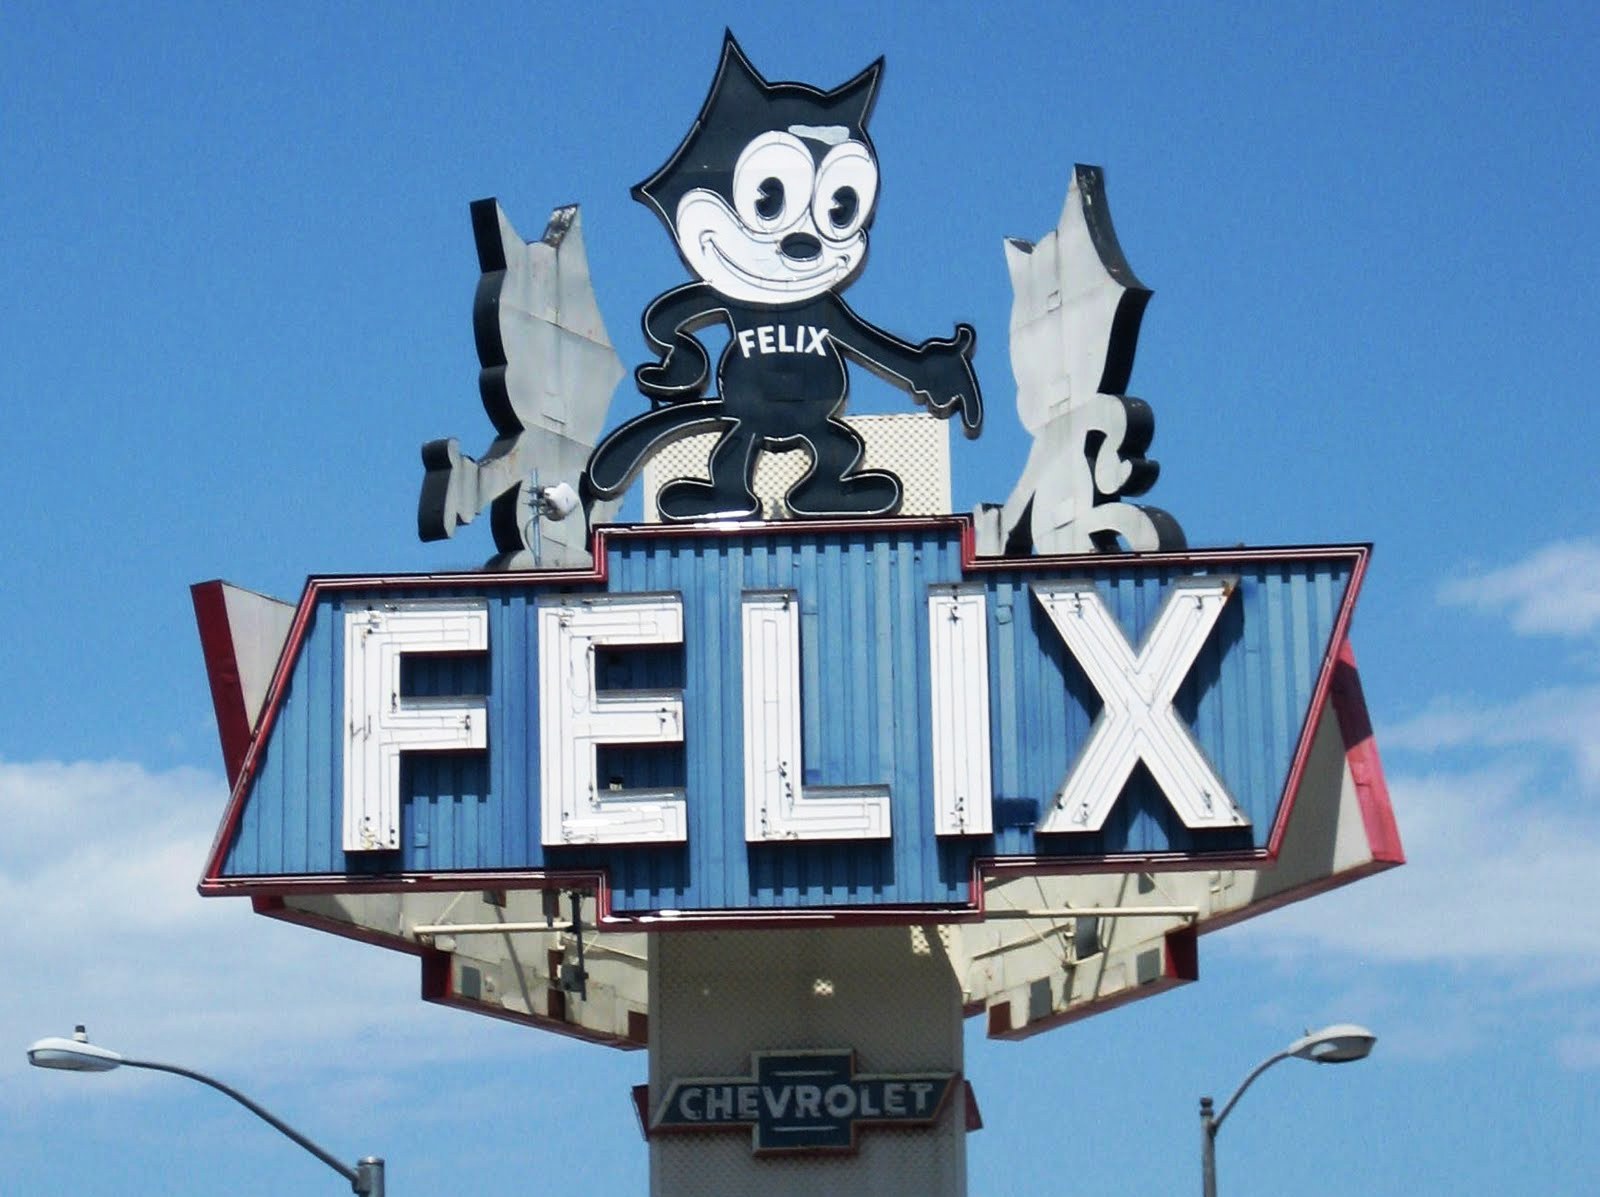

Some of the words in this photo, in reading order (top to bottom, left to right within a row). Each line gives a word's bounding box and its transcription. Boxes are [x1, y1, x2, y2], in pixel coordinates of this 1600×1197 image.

[738, 325, 829, 358] FELIX
[342, 579, 1251, 852] FELIX
[679, 1083, 935, 1121] CHEVROLET
